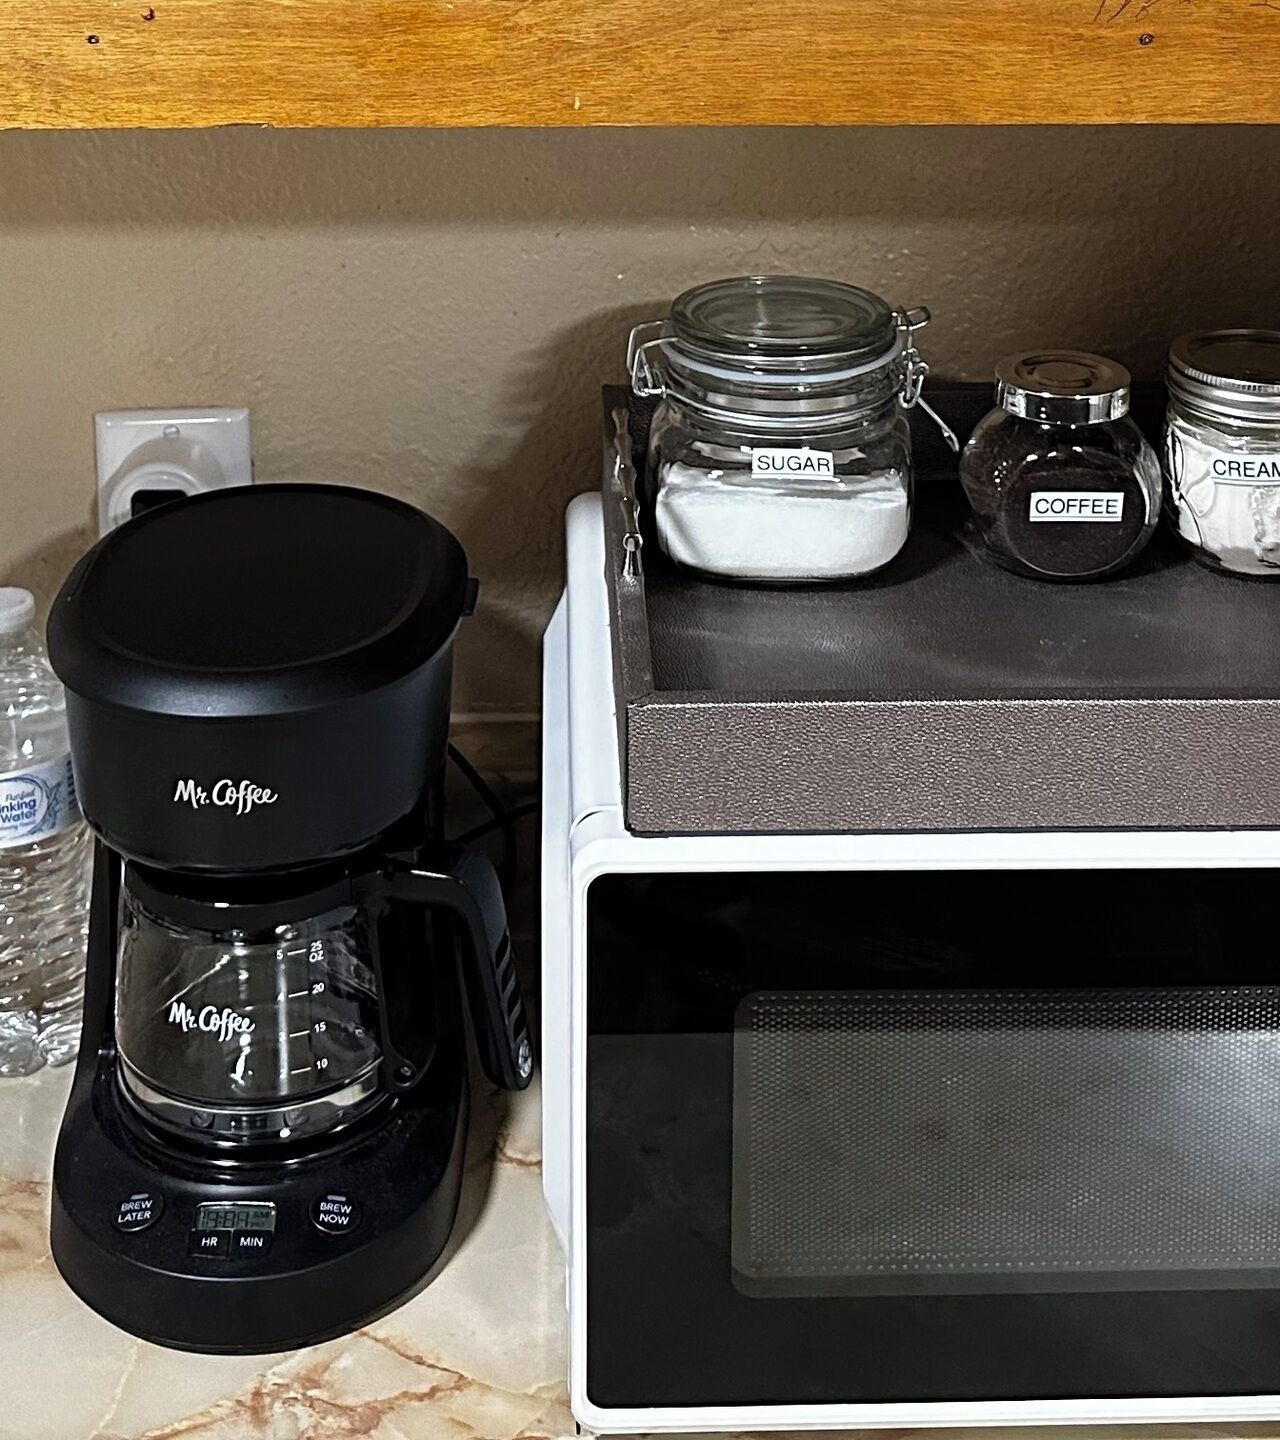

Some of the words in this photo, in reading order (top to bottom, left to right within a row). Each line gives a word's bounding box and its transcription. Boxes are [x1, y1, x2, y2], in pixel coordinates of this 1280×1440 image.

[756, 454, 831, 473] SUGAR
[1034, 497, 1119, 515] COFFEE
[173, 779, 210, 809] Mr.
[211, 778, 279, 816] Coffee
[0, 809, 38, 824] Water
[276, 949, 285, 961] 5
[310, 940, 323, 952] 25
[308, 950, 325, 963] OZ
[312, 982, 325, 995] 20
[168, 1001, 197, 1032] Mr.
[197, 1005, 256, 1042] Coffee
[314, 1021, 327, 1034] 15
[316, 1058, 329, 1070] 10
[120, 1199, 154, 1212] BREW
[319, 1201, 353, 1215] BREW
[117, 1209, 153, 1224] LATER
[319, 1212, 350, 1225] NOW
[201, 1236, 218, 1247] HR
[239, 1236, 264, 1247] MIN
